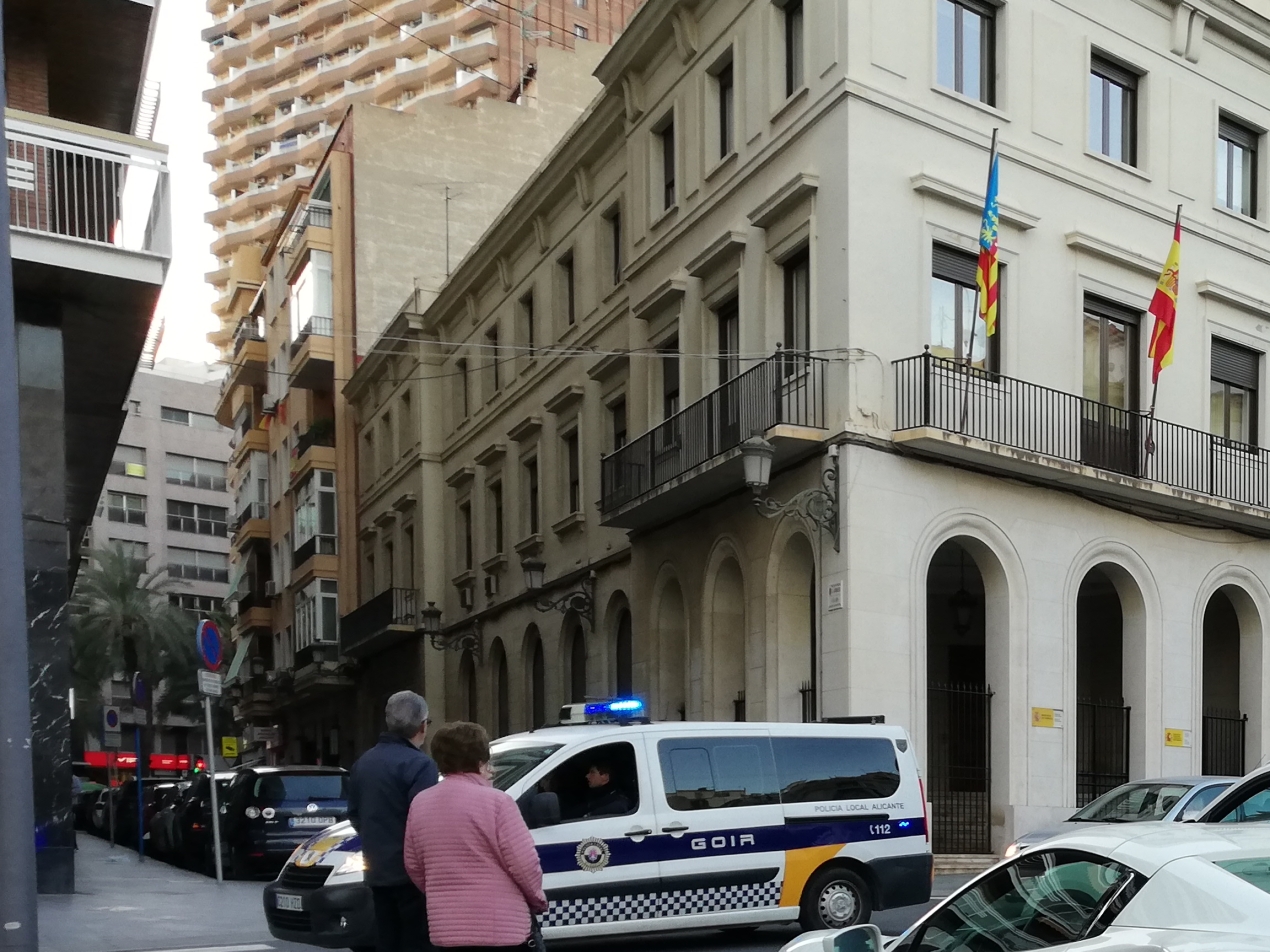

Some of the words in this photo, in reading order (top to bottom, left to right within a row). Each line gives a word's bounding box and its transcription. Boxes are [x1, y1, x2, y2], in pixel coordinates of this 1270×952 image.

[845, 804, 869, 812] LOCAL
[872, 802, 905, 811] ALICANTE
[875, 823, 891, 835] 112
